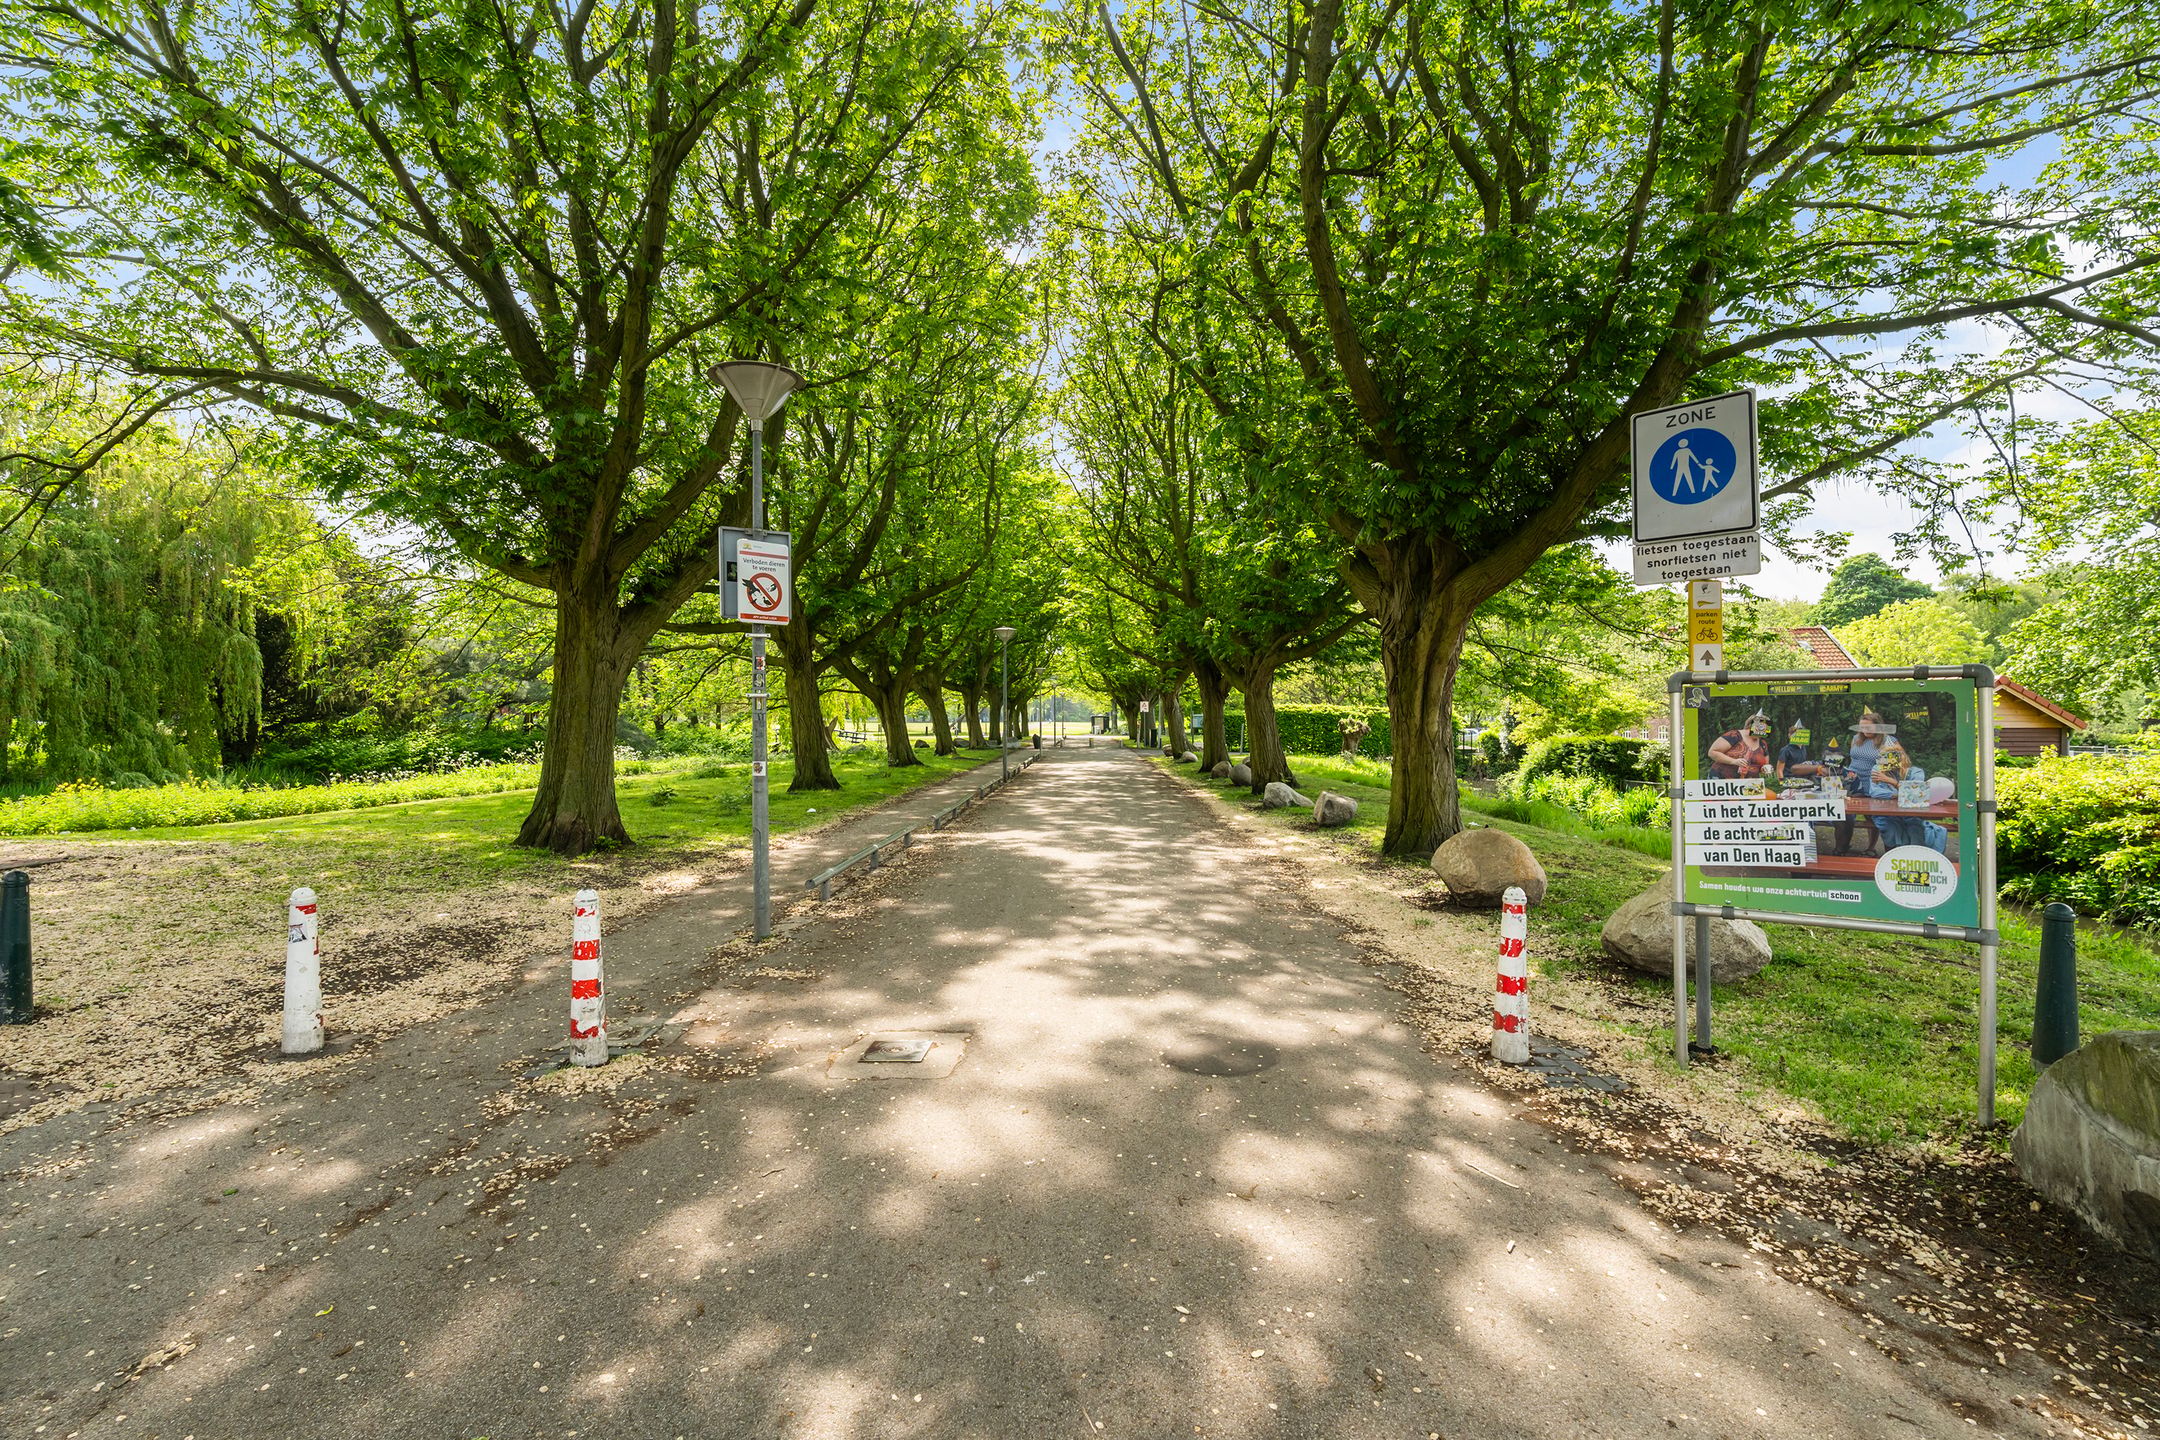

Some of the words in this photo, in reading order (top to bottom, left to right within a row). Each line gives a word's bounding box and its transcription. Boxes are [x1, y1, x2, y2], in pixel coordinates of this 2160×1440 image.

[1666, 406, 1716, 428] ZONE
[1636, 544, 1677, 556] fietsen
[1682, 535, 1757, 550] toegestaan.
[1647, 553, 1717, 568] snorfietsen
[1722, 548, 1747, 560] niet
[1661, 565, 1731, 579] toegestaan
[1702, 782, 1746, 797] Welk
[1703, 804, 1716, 818] in
[1720, 804, 1744, 818] het
[1747, 803, 1841, 820] Zuiderpark,
[1703, 827, 1720, 840] de
[1724, 826, 1805, 841] achtin
[1704, 850, 1729, 862] van
[1733, 848, 1759, 863] Den
[1764, 848, 1801, 866] Haag
[1930, 875, 1948, 885] OCH
[1699, 880, 1723, 890] Samen
[1724, 882, 1750, 893] houden
[1765, 887, 1784, 895] onze
[1785, 888, 1827, 898] achtertuin
[1830, 891, 1860, 901] schoon
